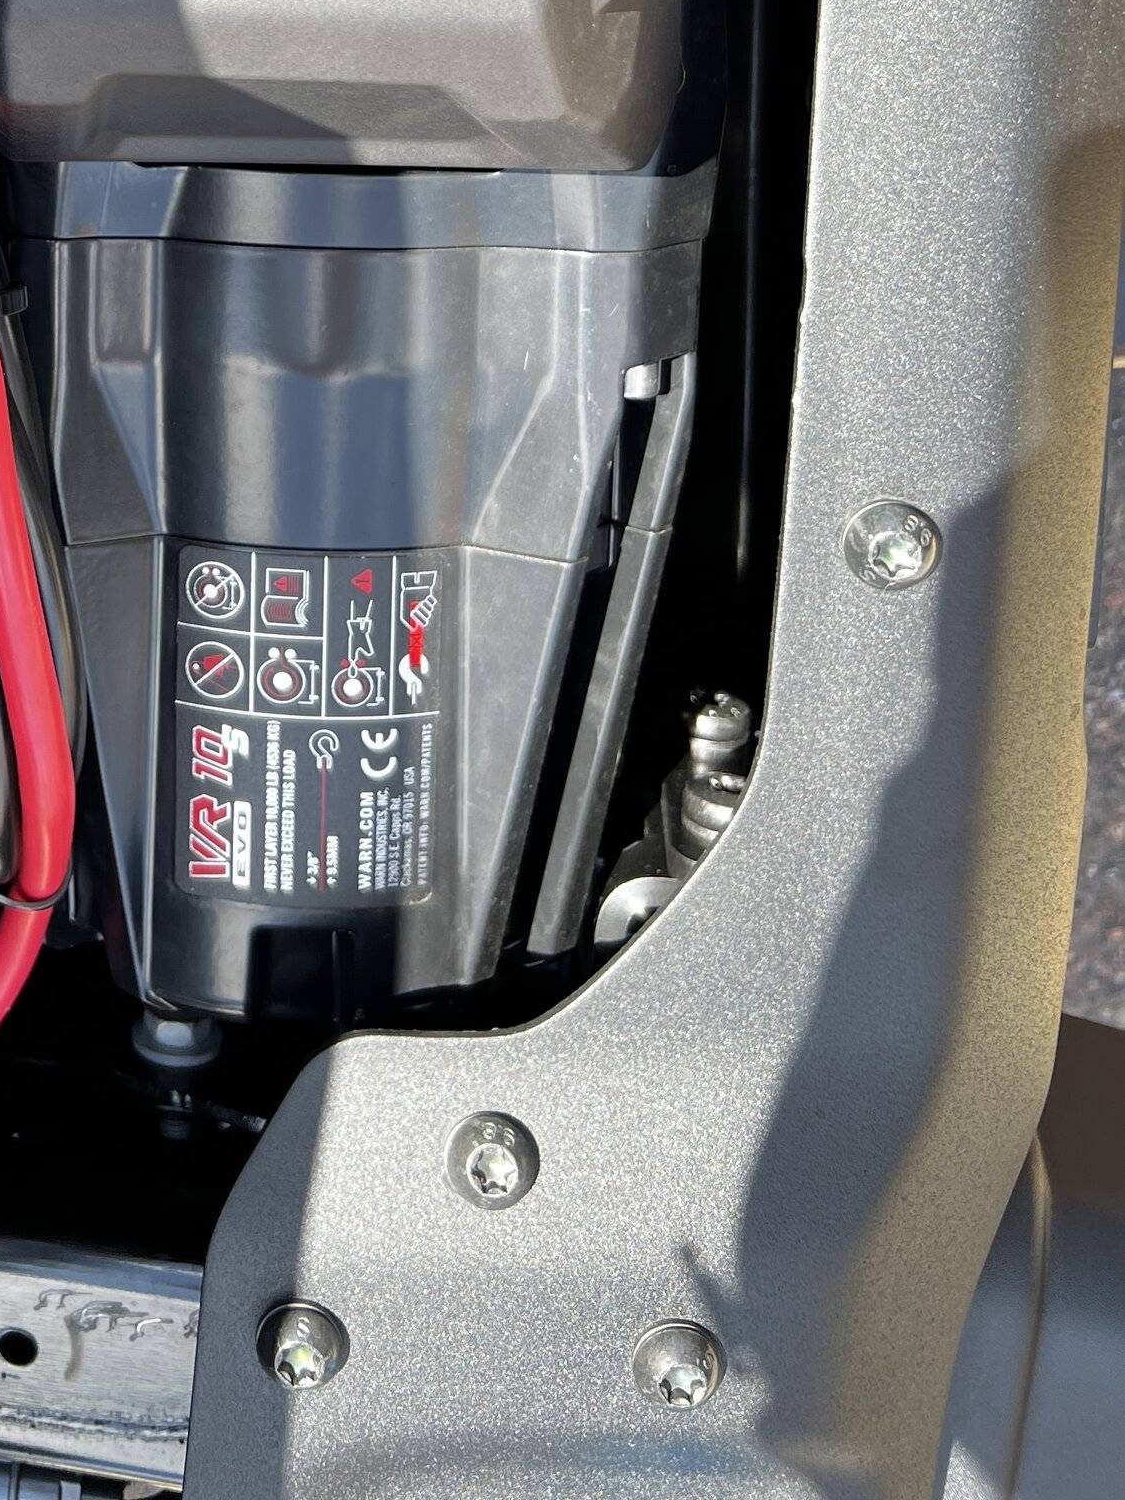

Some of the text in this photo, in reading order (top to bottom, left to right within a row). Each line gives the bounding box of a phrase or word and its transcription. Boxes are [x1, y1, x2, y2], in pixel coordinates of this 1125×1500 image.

[266, 771, 280, 786] LB
[404, 766, 416, 785] USA
[189, 793, 232, 879] VR
[280, 749, 296, 890] NEVER EXCEED THIS LOAD
[236, 810, 248, 877] EVO
[265, 822, 279, 856] LAYER
[358, 791, 374, 890] WARN.COM
[264, 857, 278, 890] FIRST
[375, 863, 387, 890] WARN
